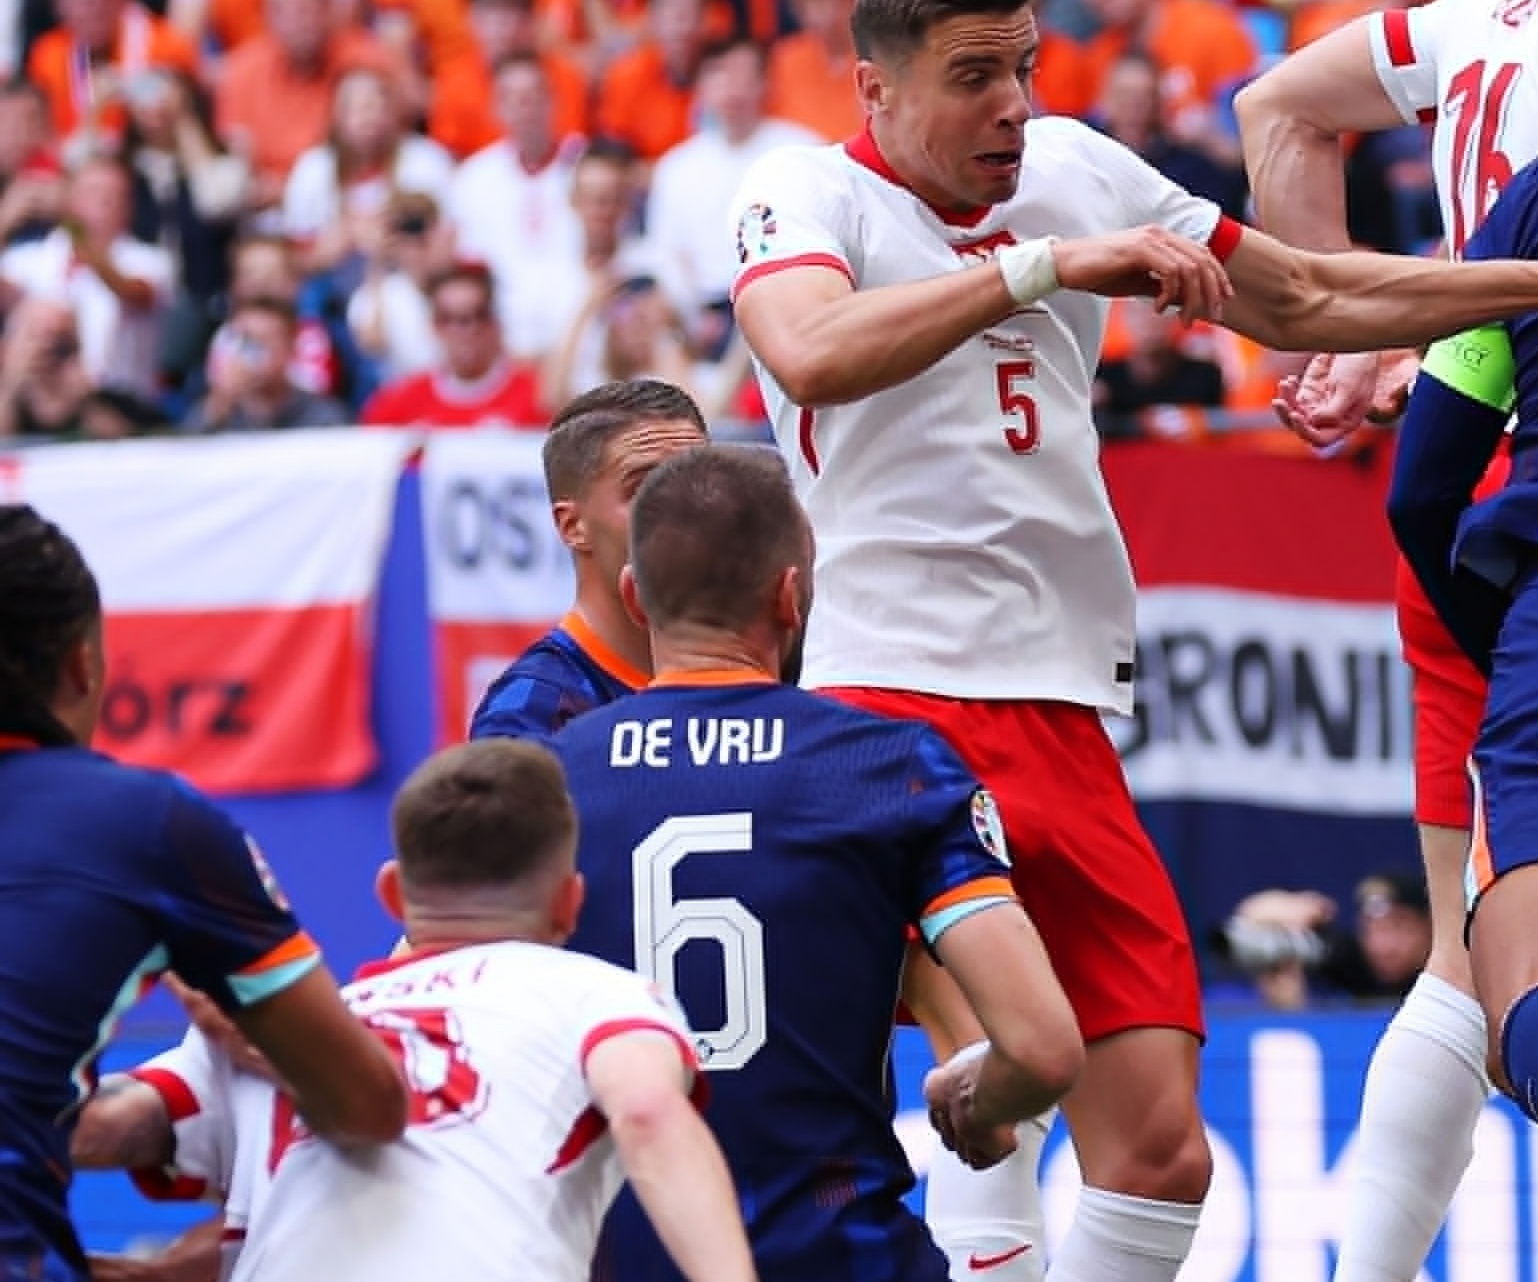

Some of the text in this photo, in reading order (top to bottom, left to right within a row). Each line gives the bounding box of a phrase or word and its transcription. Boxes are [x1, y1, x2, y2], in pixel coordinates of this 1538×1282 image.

[997, 359, 1041, 456] 5
[610, 720, 673, 767] DE
[632, 811, 767, 1071] 6
